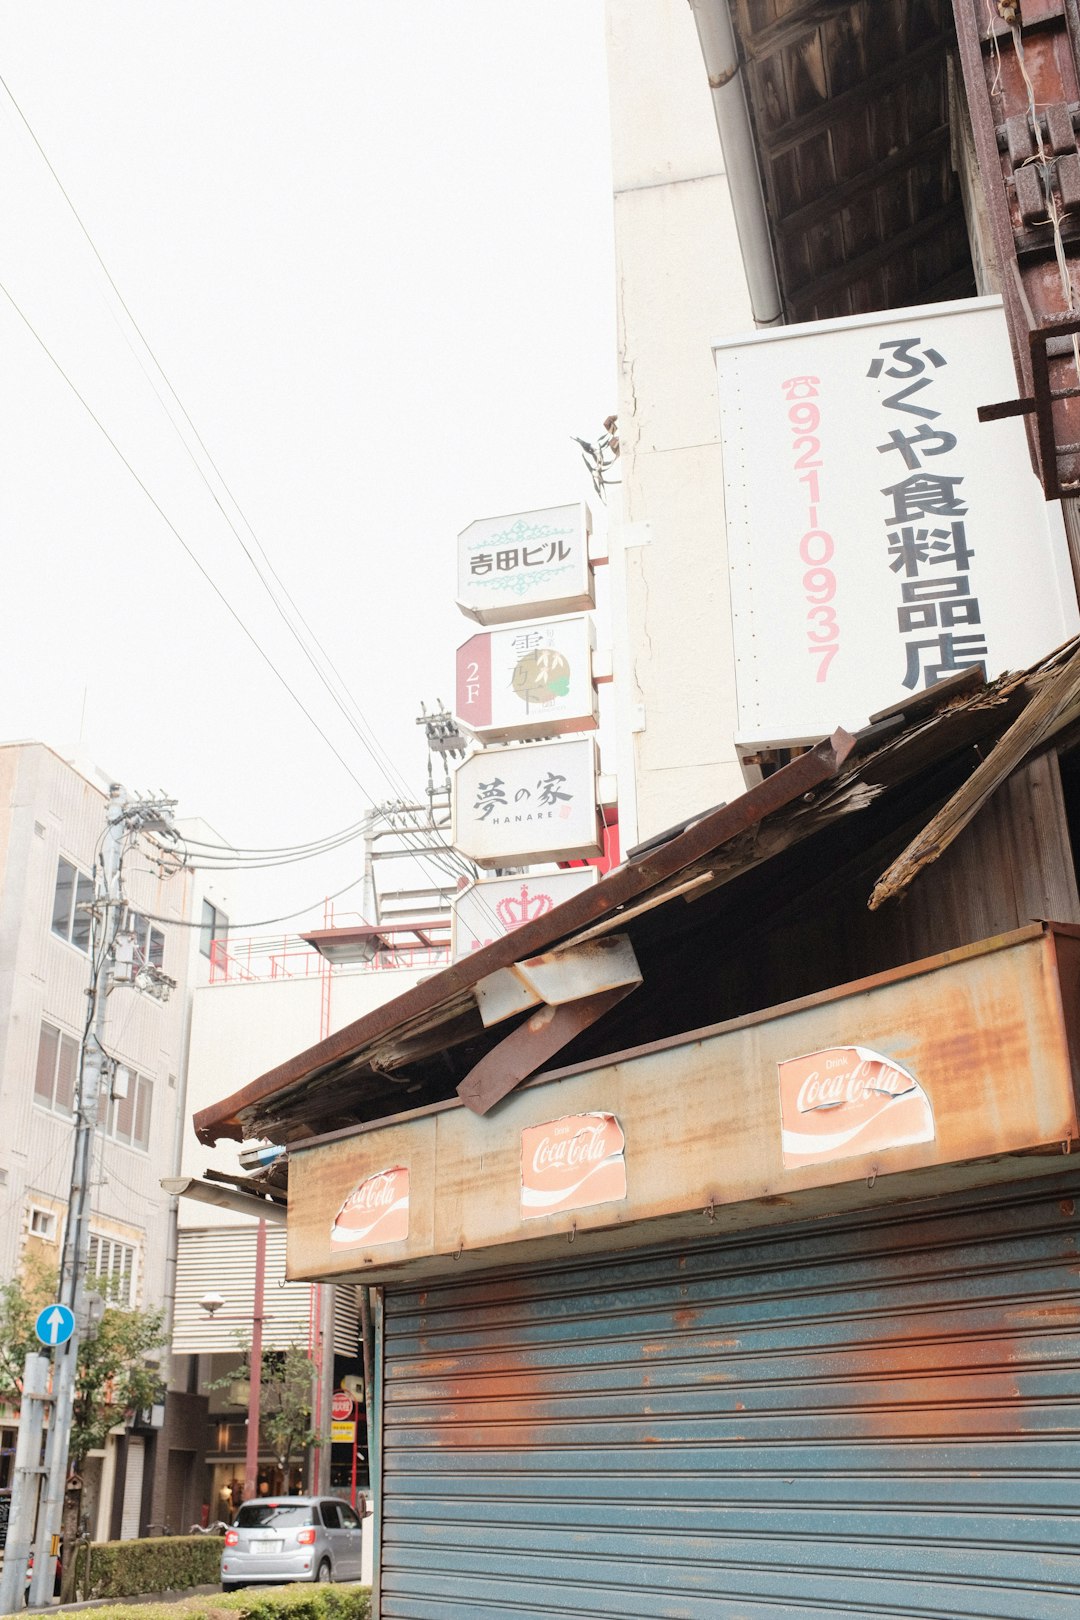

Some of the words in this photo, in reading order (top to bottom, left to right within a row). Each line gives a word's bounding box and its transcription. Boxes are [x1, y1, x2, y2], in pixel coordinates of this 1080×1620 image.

[866, 337, 988, 690] ふくや食料品店
[473, 772, 574, 820] 夢の家
[493, 811, 553, 825] HANARE
[826, 1057, 848, 1070] Drink
[532, 1122, 608, 1173] Coca-Cola
